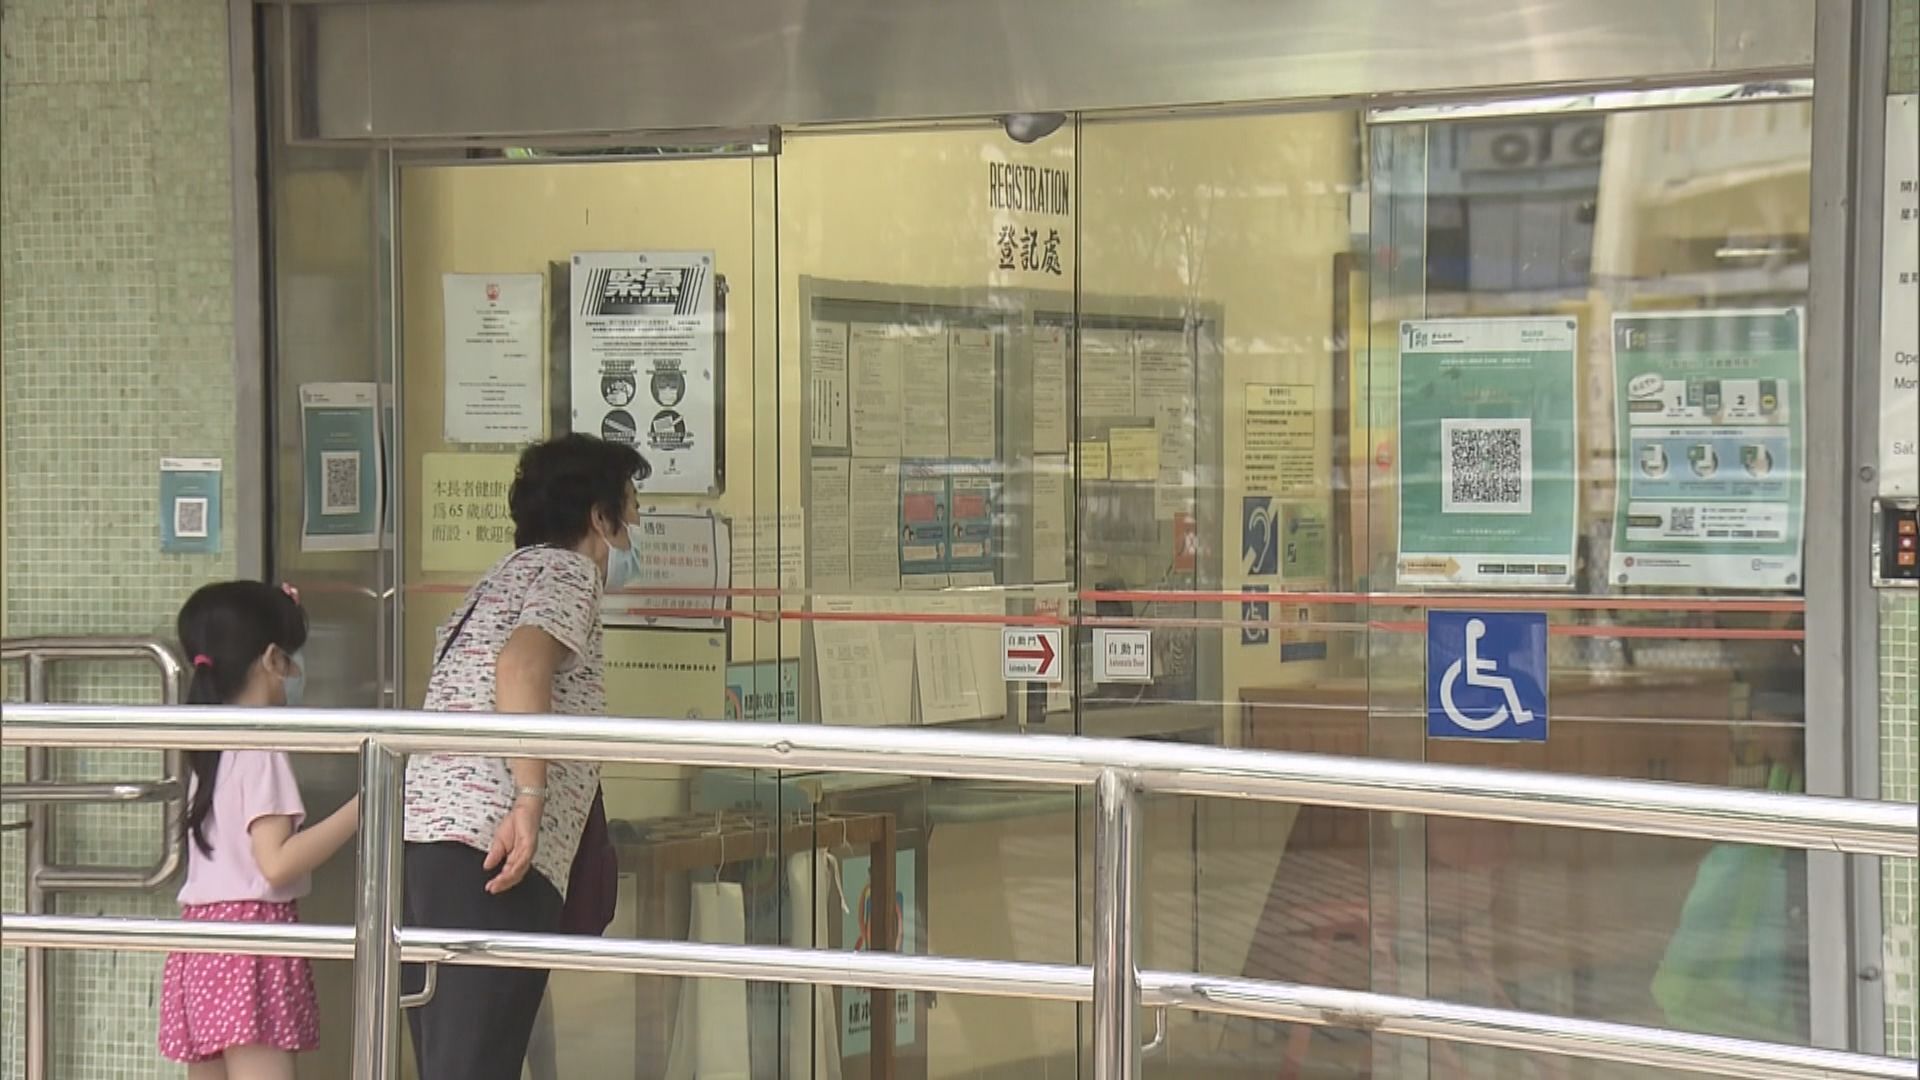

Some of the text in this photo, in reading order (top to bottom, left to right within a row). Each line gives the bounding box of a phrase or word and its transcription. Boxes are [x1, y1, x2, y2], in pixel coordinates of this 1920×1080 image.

[990, 162, 1069, 216] REGISTRATION
[997, 225, 1061, 276] 登記處
[604, 269, 682, 298] 緊急
[1736, 396, 1745, 405] 2
[449, 504, 463, 518] 65
[1008, 636, 1037, 647] 自動門
[1108, 642, 1145, 656] 自動門
